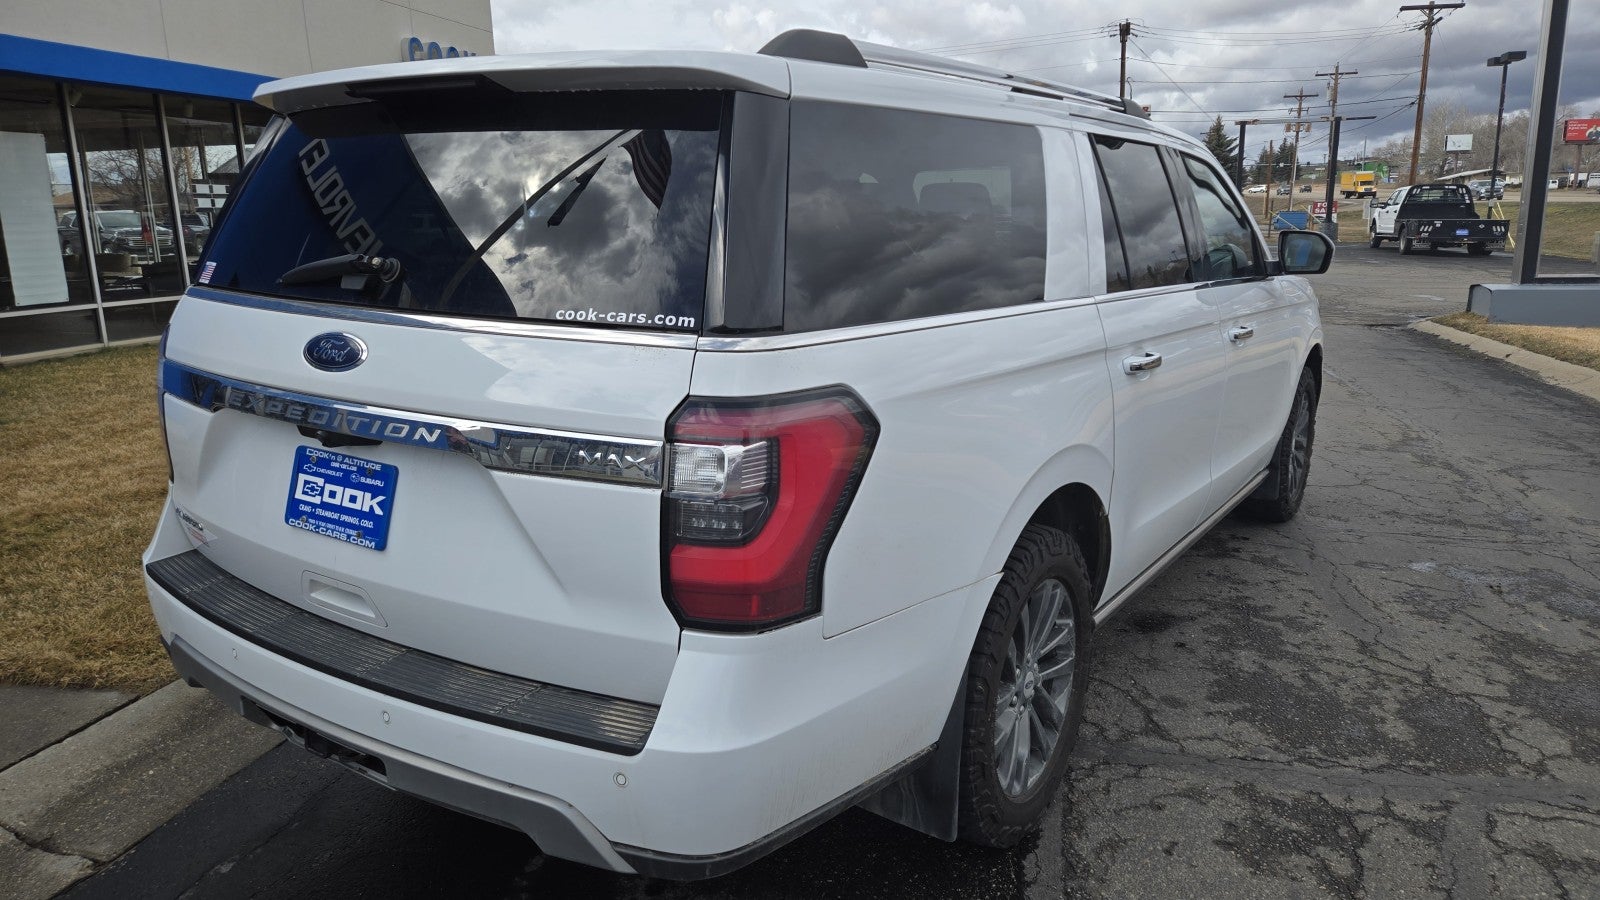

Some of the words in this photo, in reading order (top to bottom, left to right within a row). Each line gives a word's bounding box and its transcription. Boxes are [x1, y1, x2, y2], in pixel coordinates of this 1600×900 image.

[555, 307, 695, 328] cook-cars.com
[313, 338, 351, 362] Ford
[228, 389, 442, 443] EXPEDITION
[343, 457, 382, 471] ALTITUDE
[577, 449, 647, 471] MAX
[316, 467, 343, 478] CHEVROLET
[360, 476, 385, 487] SUBARU
[294, 472, 387, 516] COOK
[298, 503, 312, 513] CRAIG
[315, 508, 340, 520] STEAMBOAT
[288, 518, 376, 549] COOK-CARS.COM
